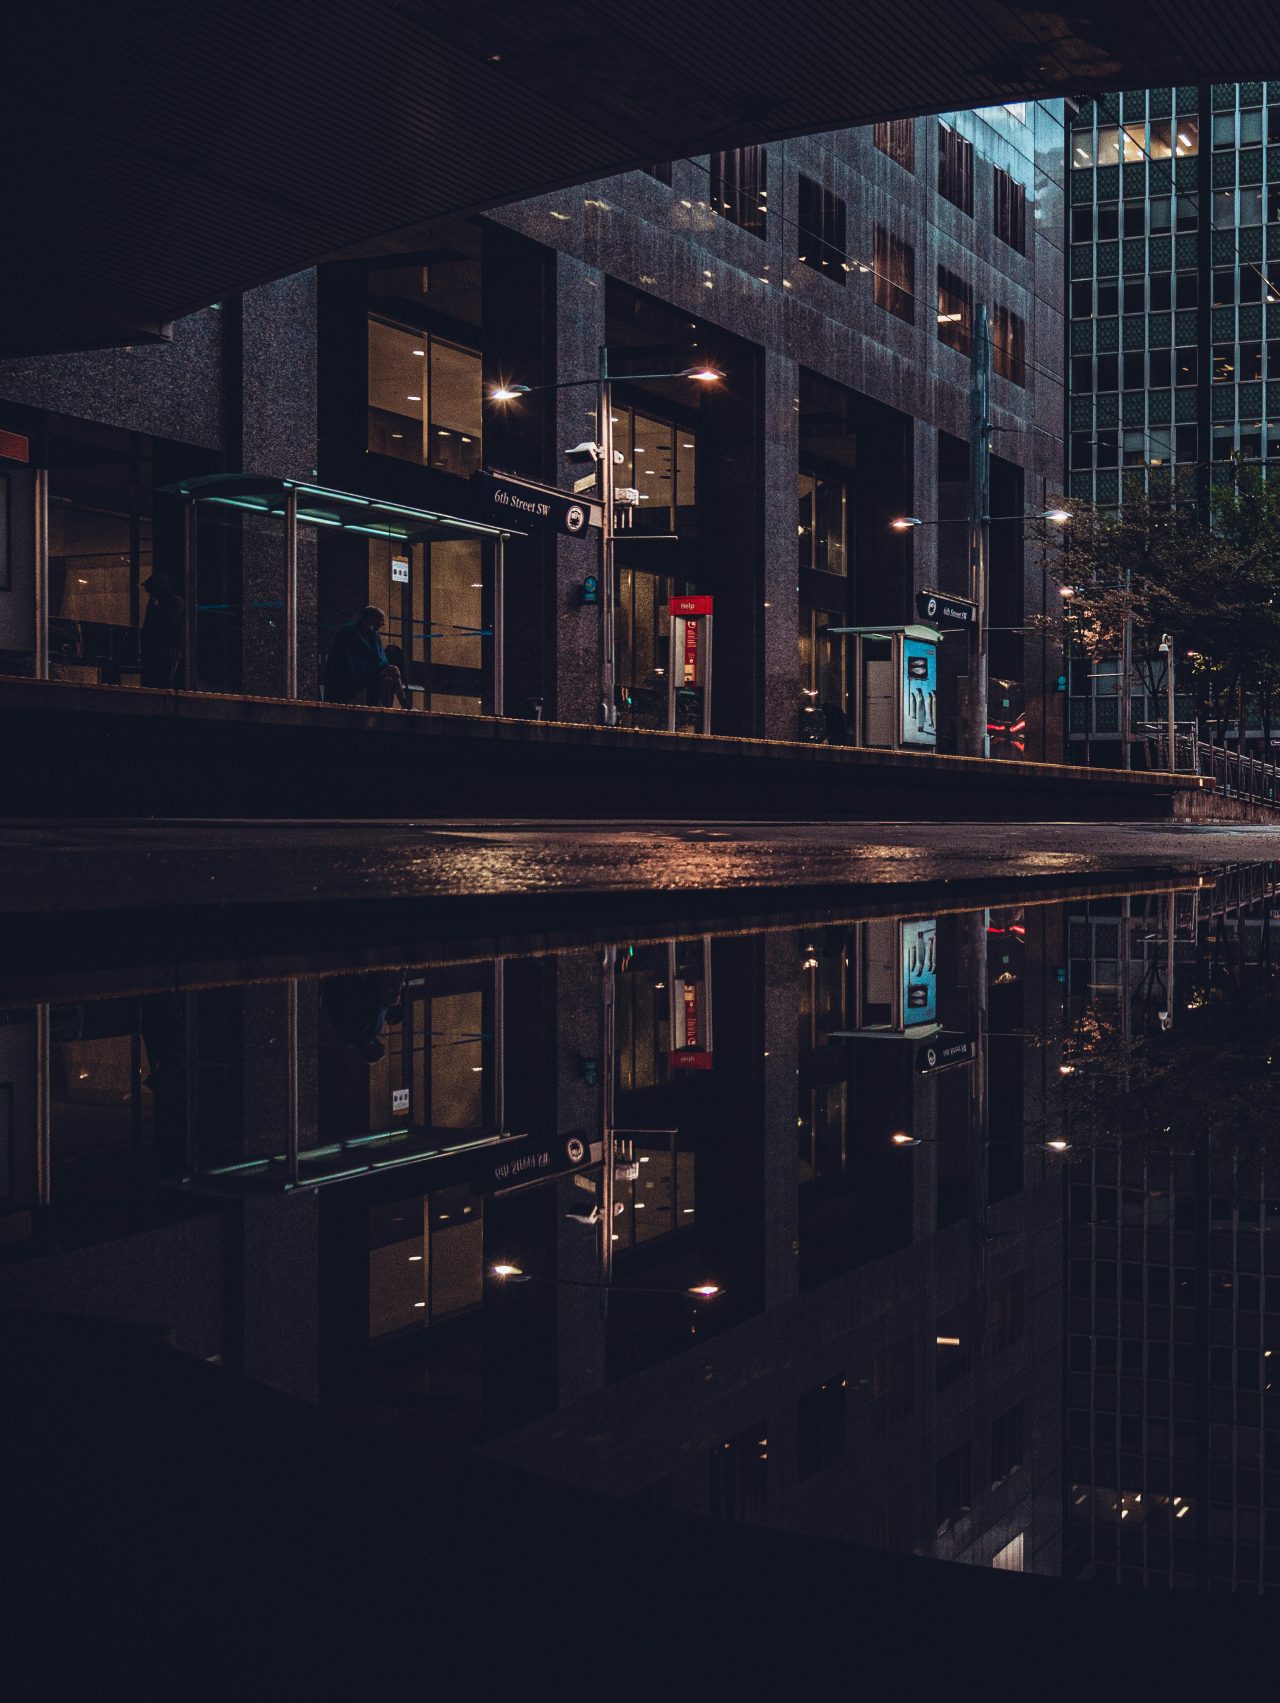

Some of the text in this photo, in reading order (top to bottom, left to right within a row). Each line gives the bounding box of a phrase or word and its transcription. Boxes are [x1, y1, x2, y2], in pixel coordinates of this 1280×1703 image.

[494, 489, 551, 517] 6th Street SW
[680, 602, 695, 610] Help
